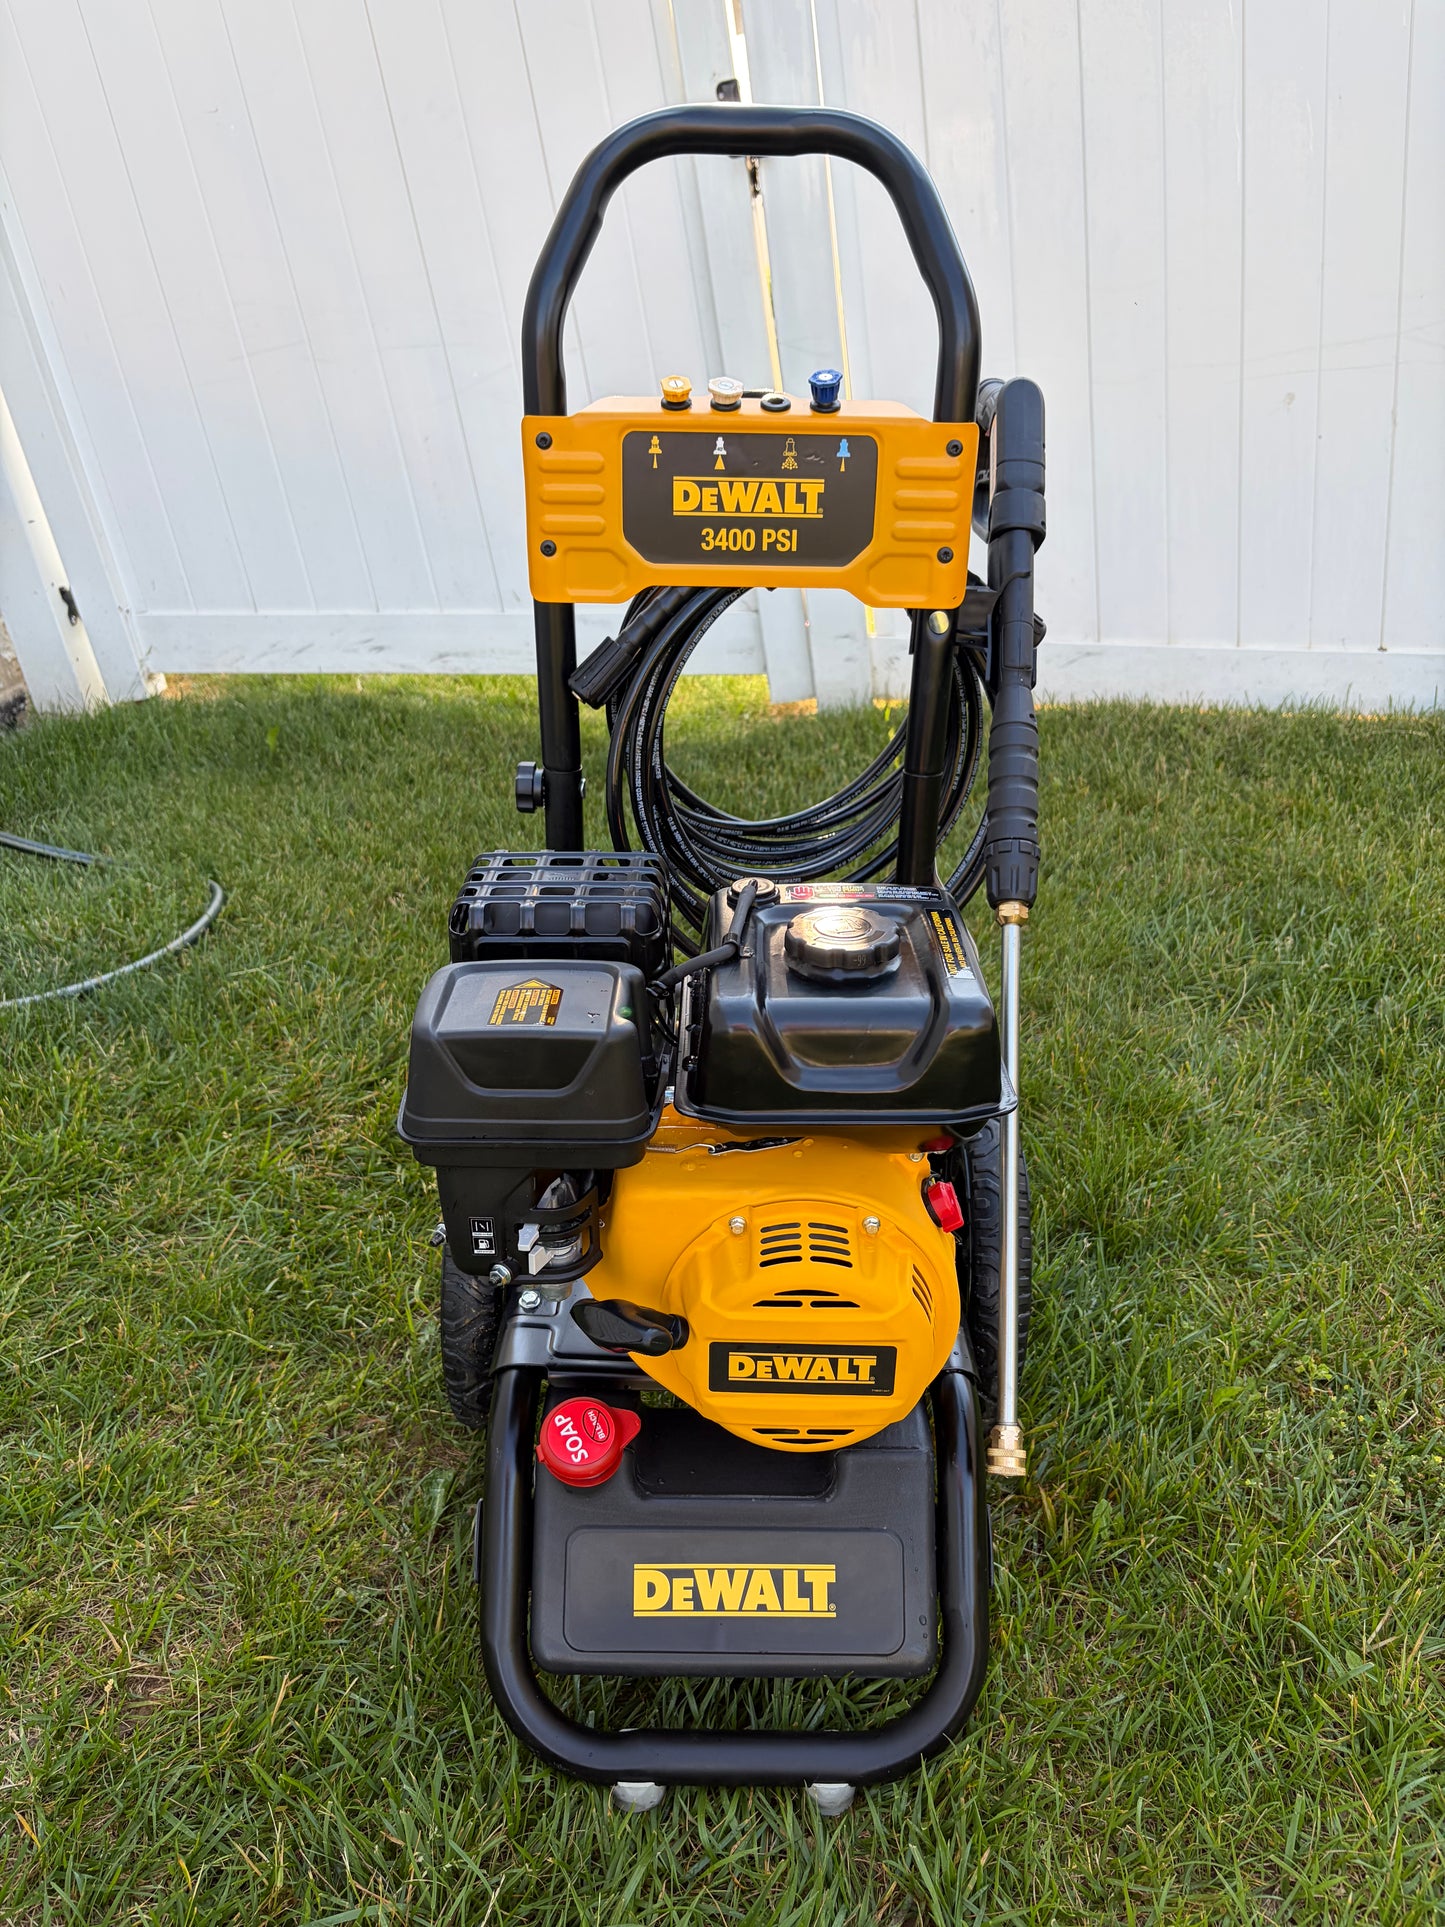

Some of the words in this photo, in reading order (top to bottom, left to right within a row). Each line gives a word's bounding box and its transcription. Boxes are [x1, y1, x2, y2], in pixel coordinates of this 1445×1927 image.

[700, 528, 756, 552] 3400
[762, 528, 798, 552] PSI
[930, 911, 946, 935] CALIFORNIA
[941, 940, 952, 953] SALE
[944, 953, 954, 964] FOR
[947, 964, 957, 975] NOT
[554, 1414, 589, 1463] SOAP
